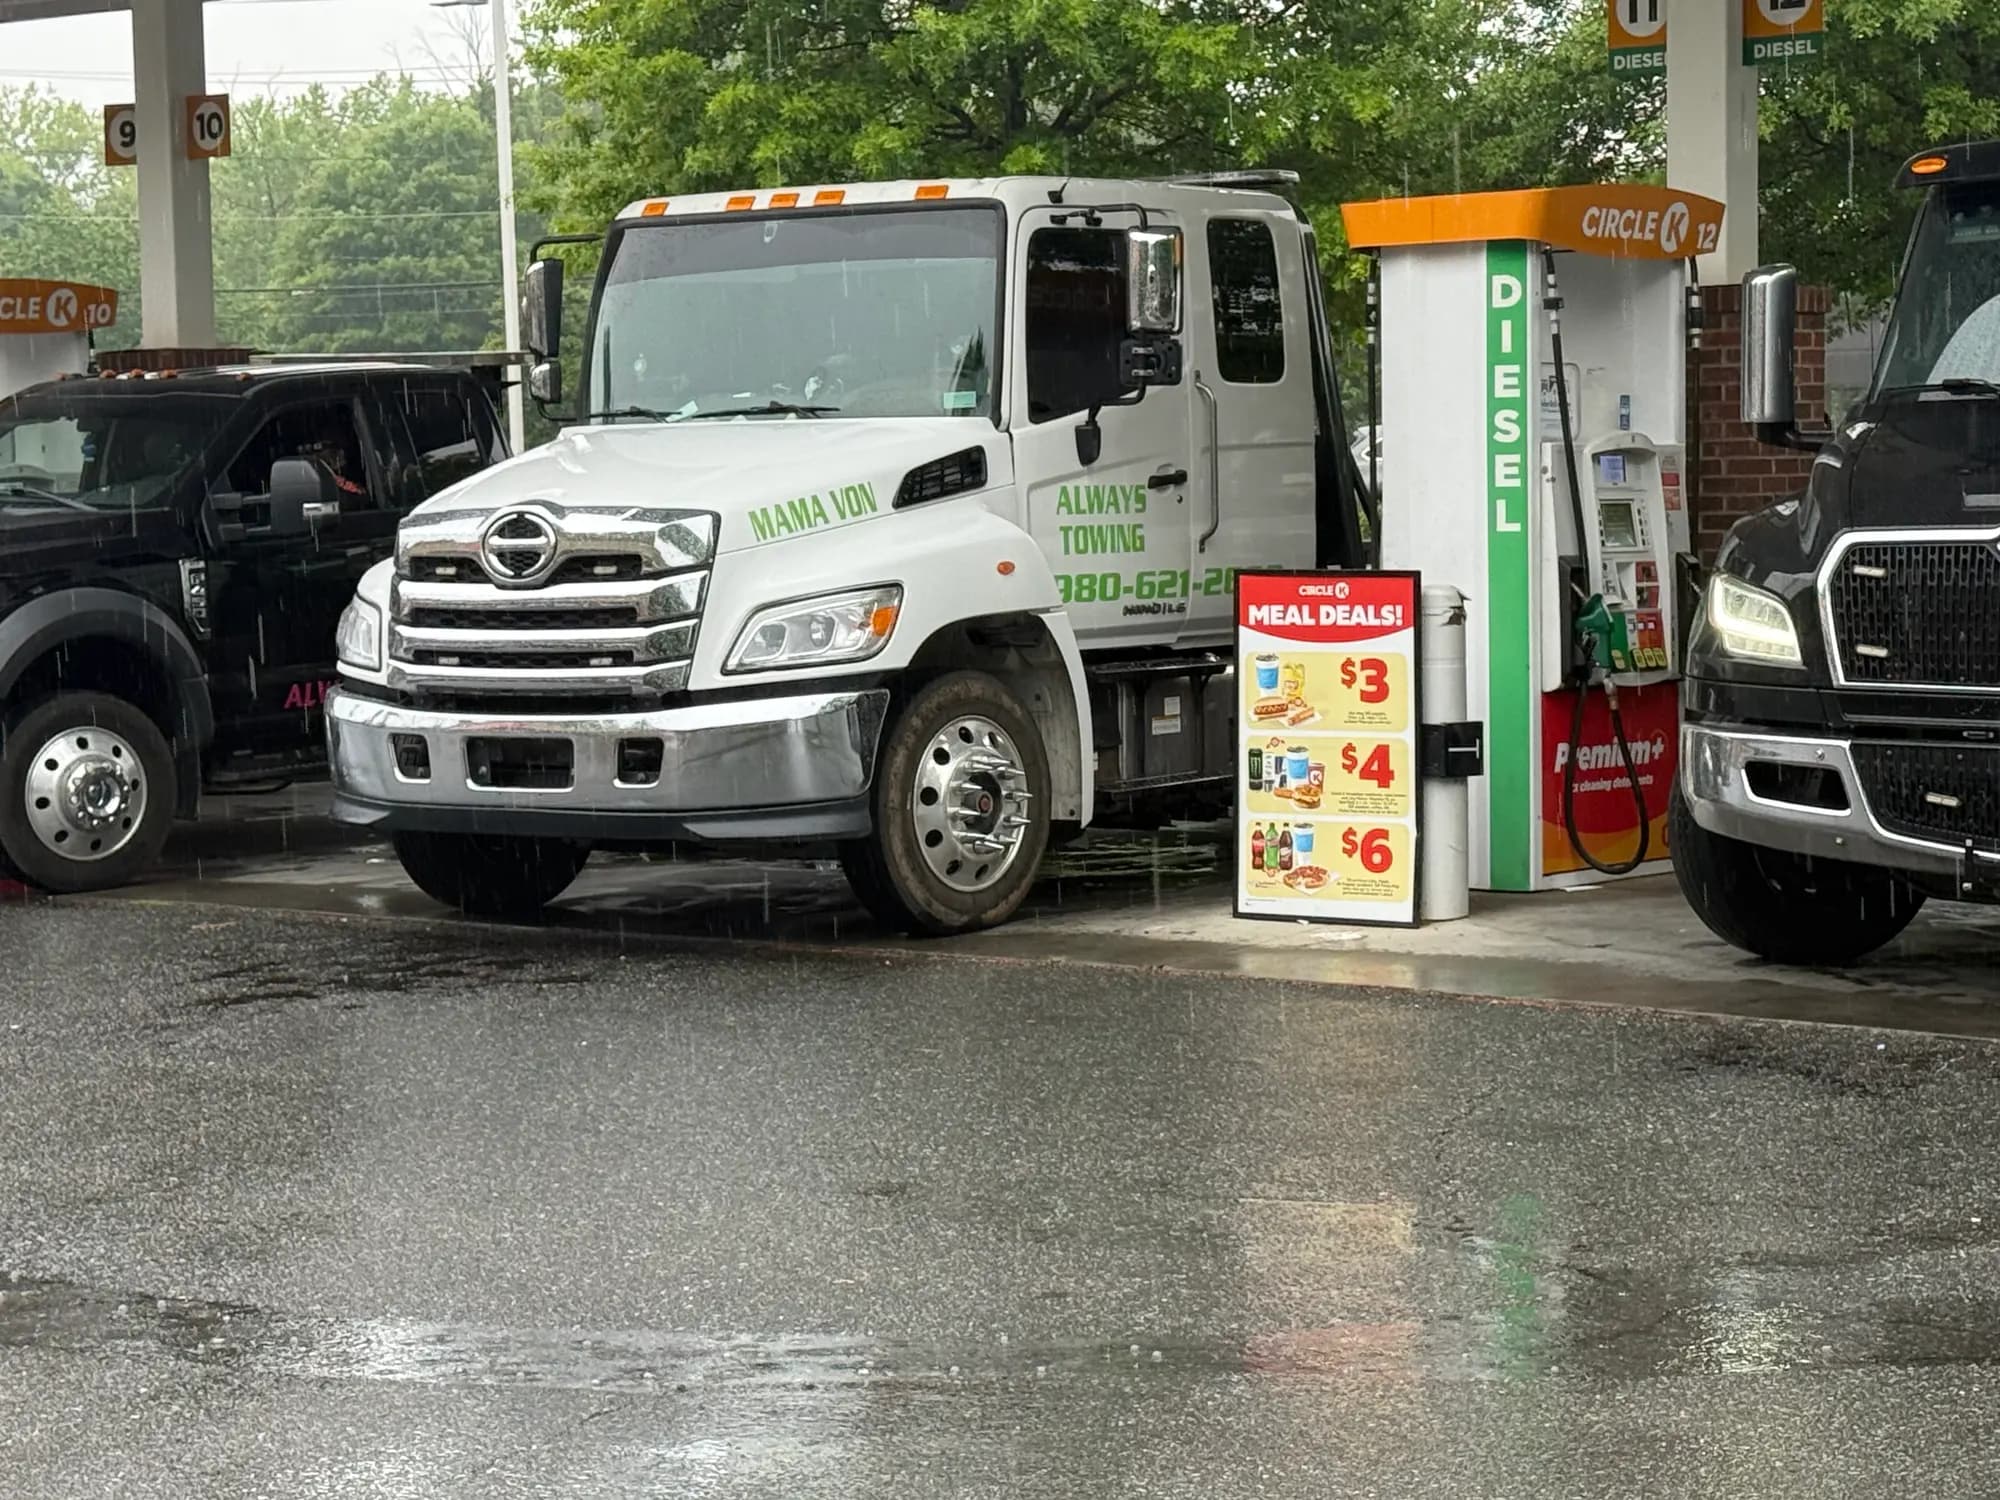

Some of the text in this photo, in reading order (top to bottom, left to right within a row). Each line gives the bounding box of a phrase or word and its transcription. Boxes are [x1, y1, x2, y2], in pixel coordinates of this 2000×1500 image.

[1753, 40, 1817, 59] DIESEL
[119, 120, 137, 149] 9
[196, 112, 223, 141] 10
[1582, 203, 1717, 253] CIRCLE K 12
[48, 290, 77, 326] K
[87, 304, 111, 324] 10
[1491, 274, 1523, 532] DIESEL
[748, 481, 878, 542] MAMA VON
[1056, 484, 1147, 516] ALWAYS
[1059, 523, 1146, 556] TOWING
[1299, 582, 1349, 599] CIRCLE K
[1248, 604, 1404, 627] MEAL DEALS!
[1340, 656, 1390, 704] $3
[1341, 742, 1395, 789] $4
[1553, 735, 1665, 774] Pemim+
[1342, 826, 1394, 874] $6
